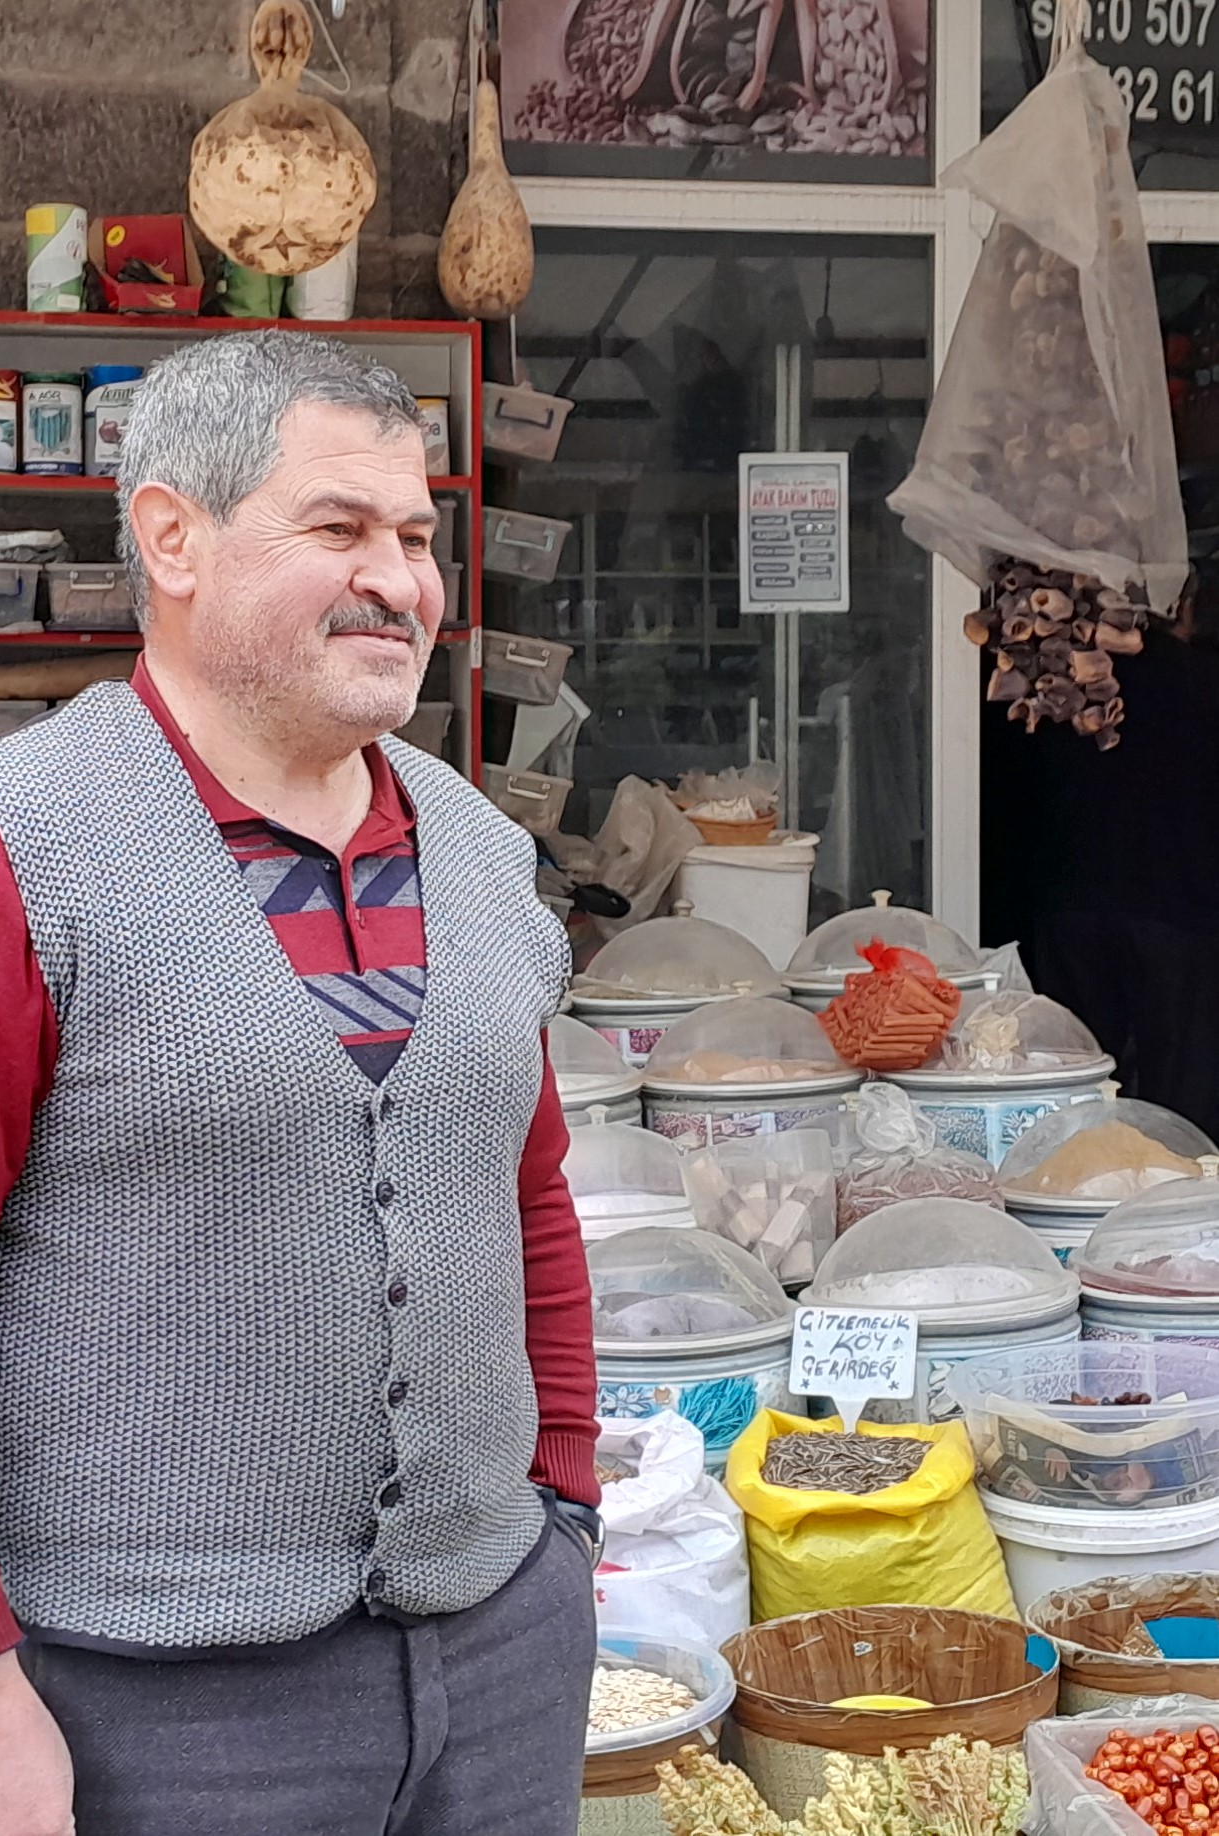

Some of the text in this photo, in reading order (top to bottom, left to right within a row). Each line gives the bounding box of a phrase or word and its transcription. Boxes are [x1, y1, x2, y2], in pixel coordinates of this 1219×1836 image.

[1145, 0, 1215, 47] 507
[1172, 69, 1214, 123] 61
[829, 1331, 888, 1358] KÖY
